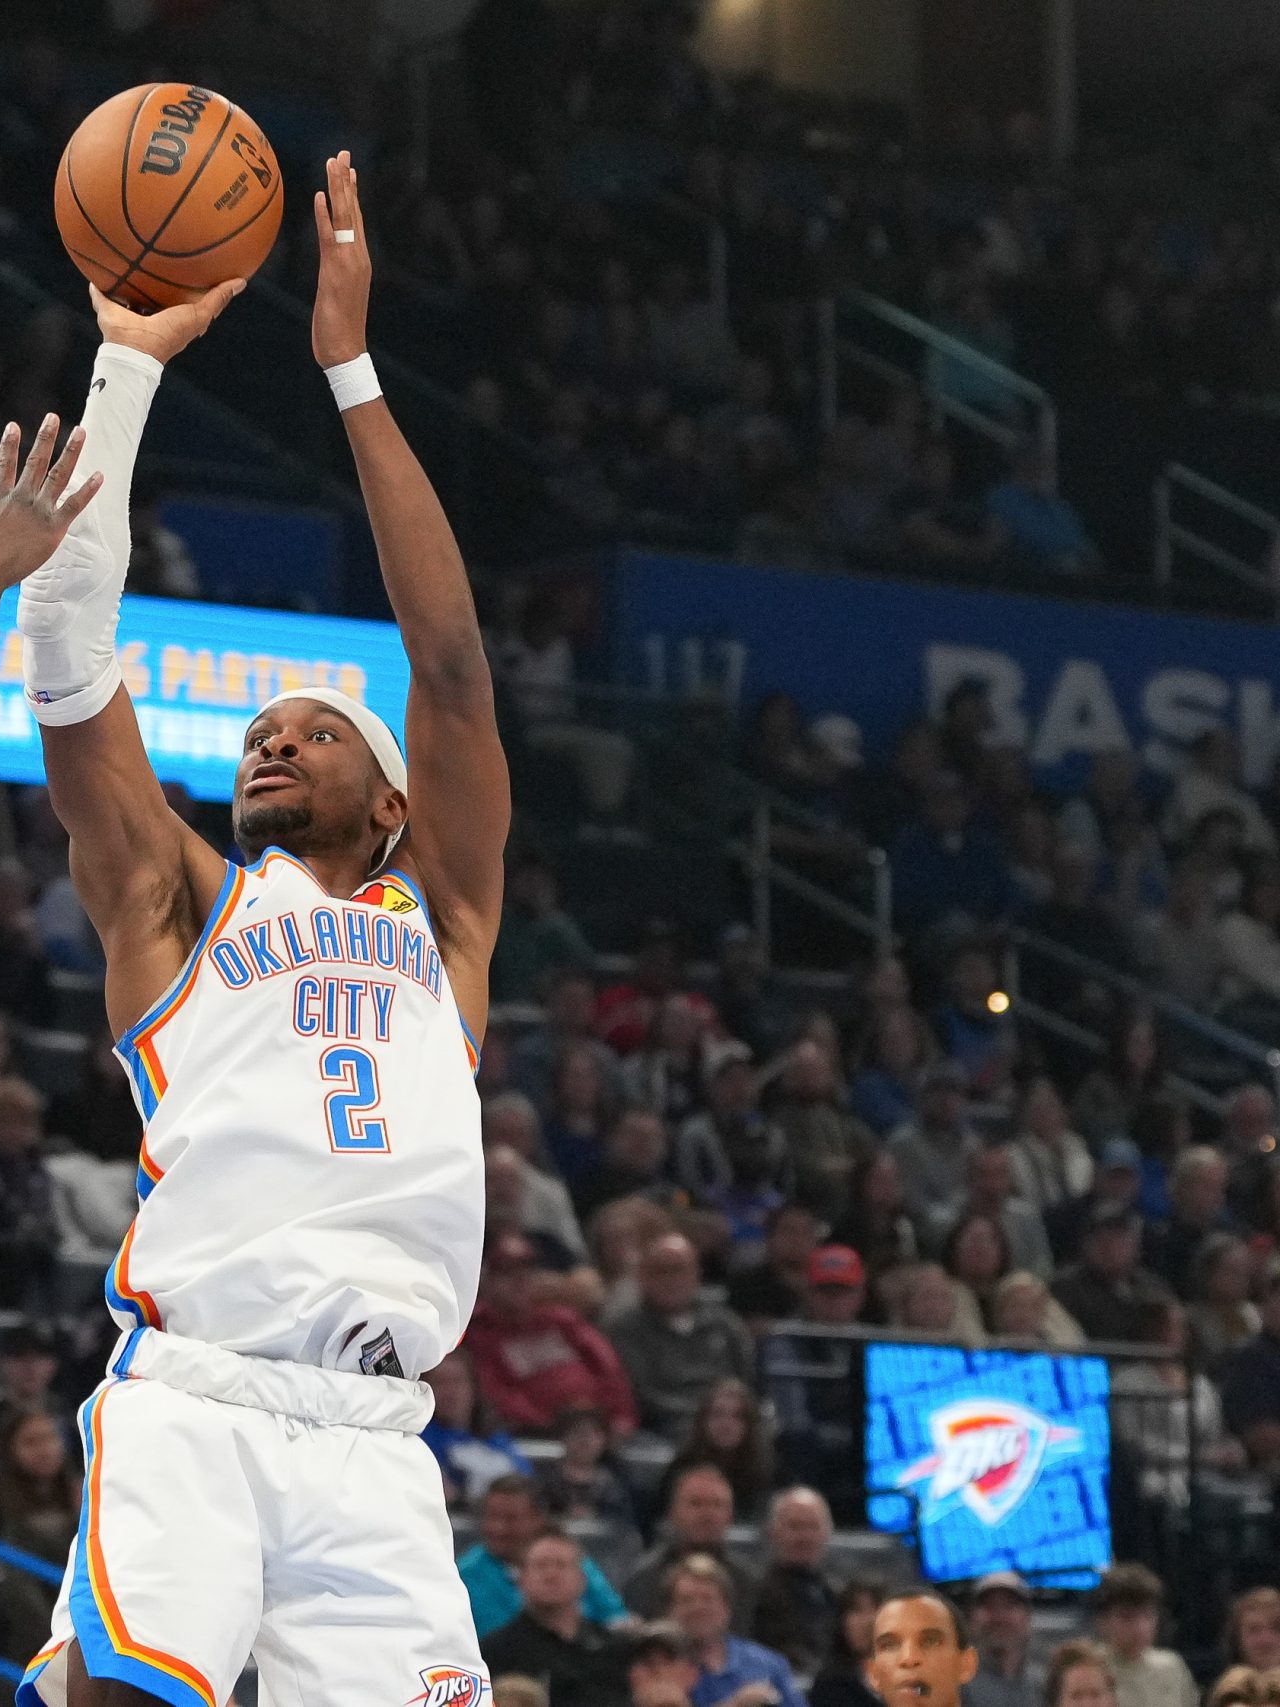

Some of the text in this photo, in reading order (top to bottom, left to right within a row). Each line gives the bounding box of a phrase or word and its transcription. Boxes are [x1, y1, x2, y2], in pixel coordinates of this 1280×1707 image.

[139, 84, 214, 176] Wilso
[208, 906, 444, 1003] OKLAHOMA
[293, 976, 397, 1042] CITY
[320, 1043, 392, 1154] 2
[424, 1675, 471, 1707] OKC
